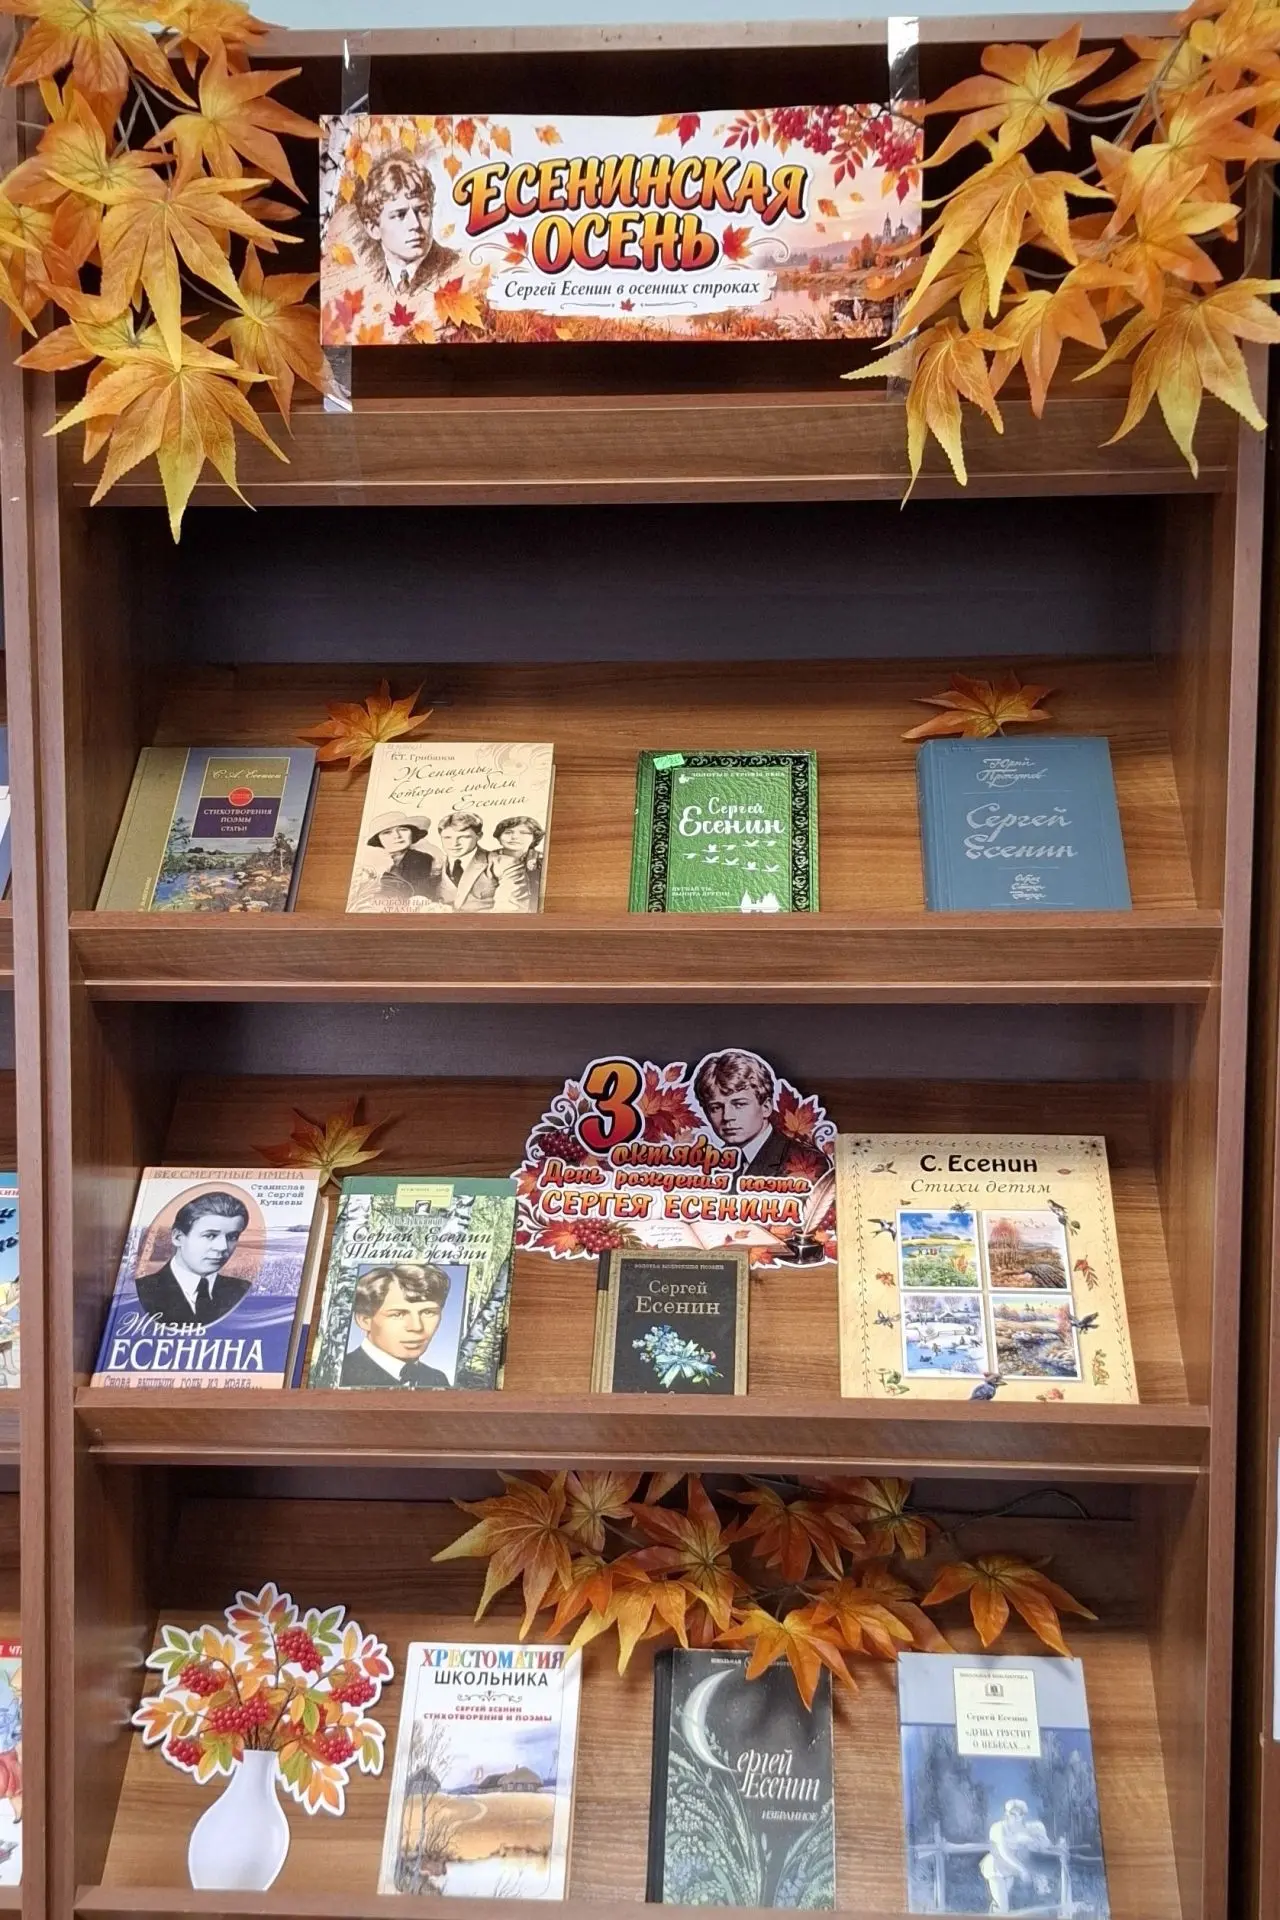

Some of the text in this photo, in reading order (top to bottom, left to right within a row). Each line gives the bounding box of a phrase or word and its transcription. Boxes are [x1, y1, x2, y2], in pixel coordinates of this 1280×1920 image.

[453, 154, 808, 236] ЕСЕНИНСКАЯ
[531, 211, 720, 273] ОСЕНЬ
[505, 280, 760, 299] Сергей Есенин в осенних строках
[388, 770, 517, 808] которые любили
[452, 794, 527, 811] Есенина
[708, 797, 765, 818] Сергей
[679, 805, 785, 836] Есенин
[966, 803, 1072, 842] Сергей
[963, 834, 1078, 859] Есенин
[579, 1060, 642, 1149] 3
[611, 1135, 738, 1174] октября
[920, 1155, 1038, 1173] С. Есенин
[154, 1170, 304, 1180] БЕССМЕРТНЫЕ ИМЕНА
[541, 1159, 811, 1194] День рождения поэта
[267, 1191, 304, 1200] Сергей
[911, 1179, 1051, 1194] Стихи детям
[541, 1190, 802, 1223] СЕРГЕЯ ЕСЕНИНА
[353, 1222, 491, 1247] Сергей Есенин
[344, 1243, 487, 1263] Тайна жизни
[649, 1280, 708, 1297] Сергей
[635, 1295, 720, 1315] Есенин
[116, 1312, 207, 1337] Жизнь
[108, 1339, 264, 1371] ЕСЕНИНА
[104, 1375, 130, 1388] Снова
[420, 1649, 565, 1669] ХРЕСТОМАТИЯ
[434, 1670, 548, 1686] ШКОЛЬНИКА
[967, 1713, 1028, 1722] Сергей Есенин
[745, 1770, 820, 1800] Есенин
[761, 1810, 818, 1822] ИЗБРАННОЕ
